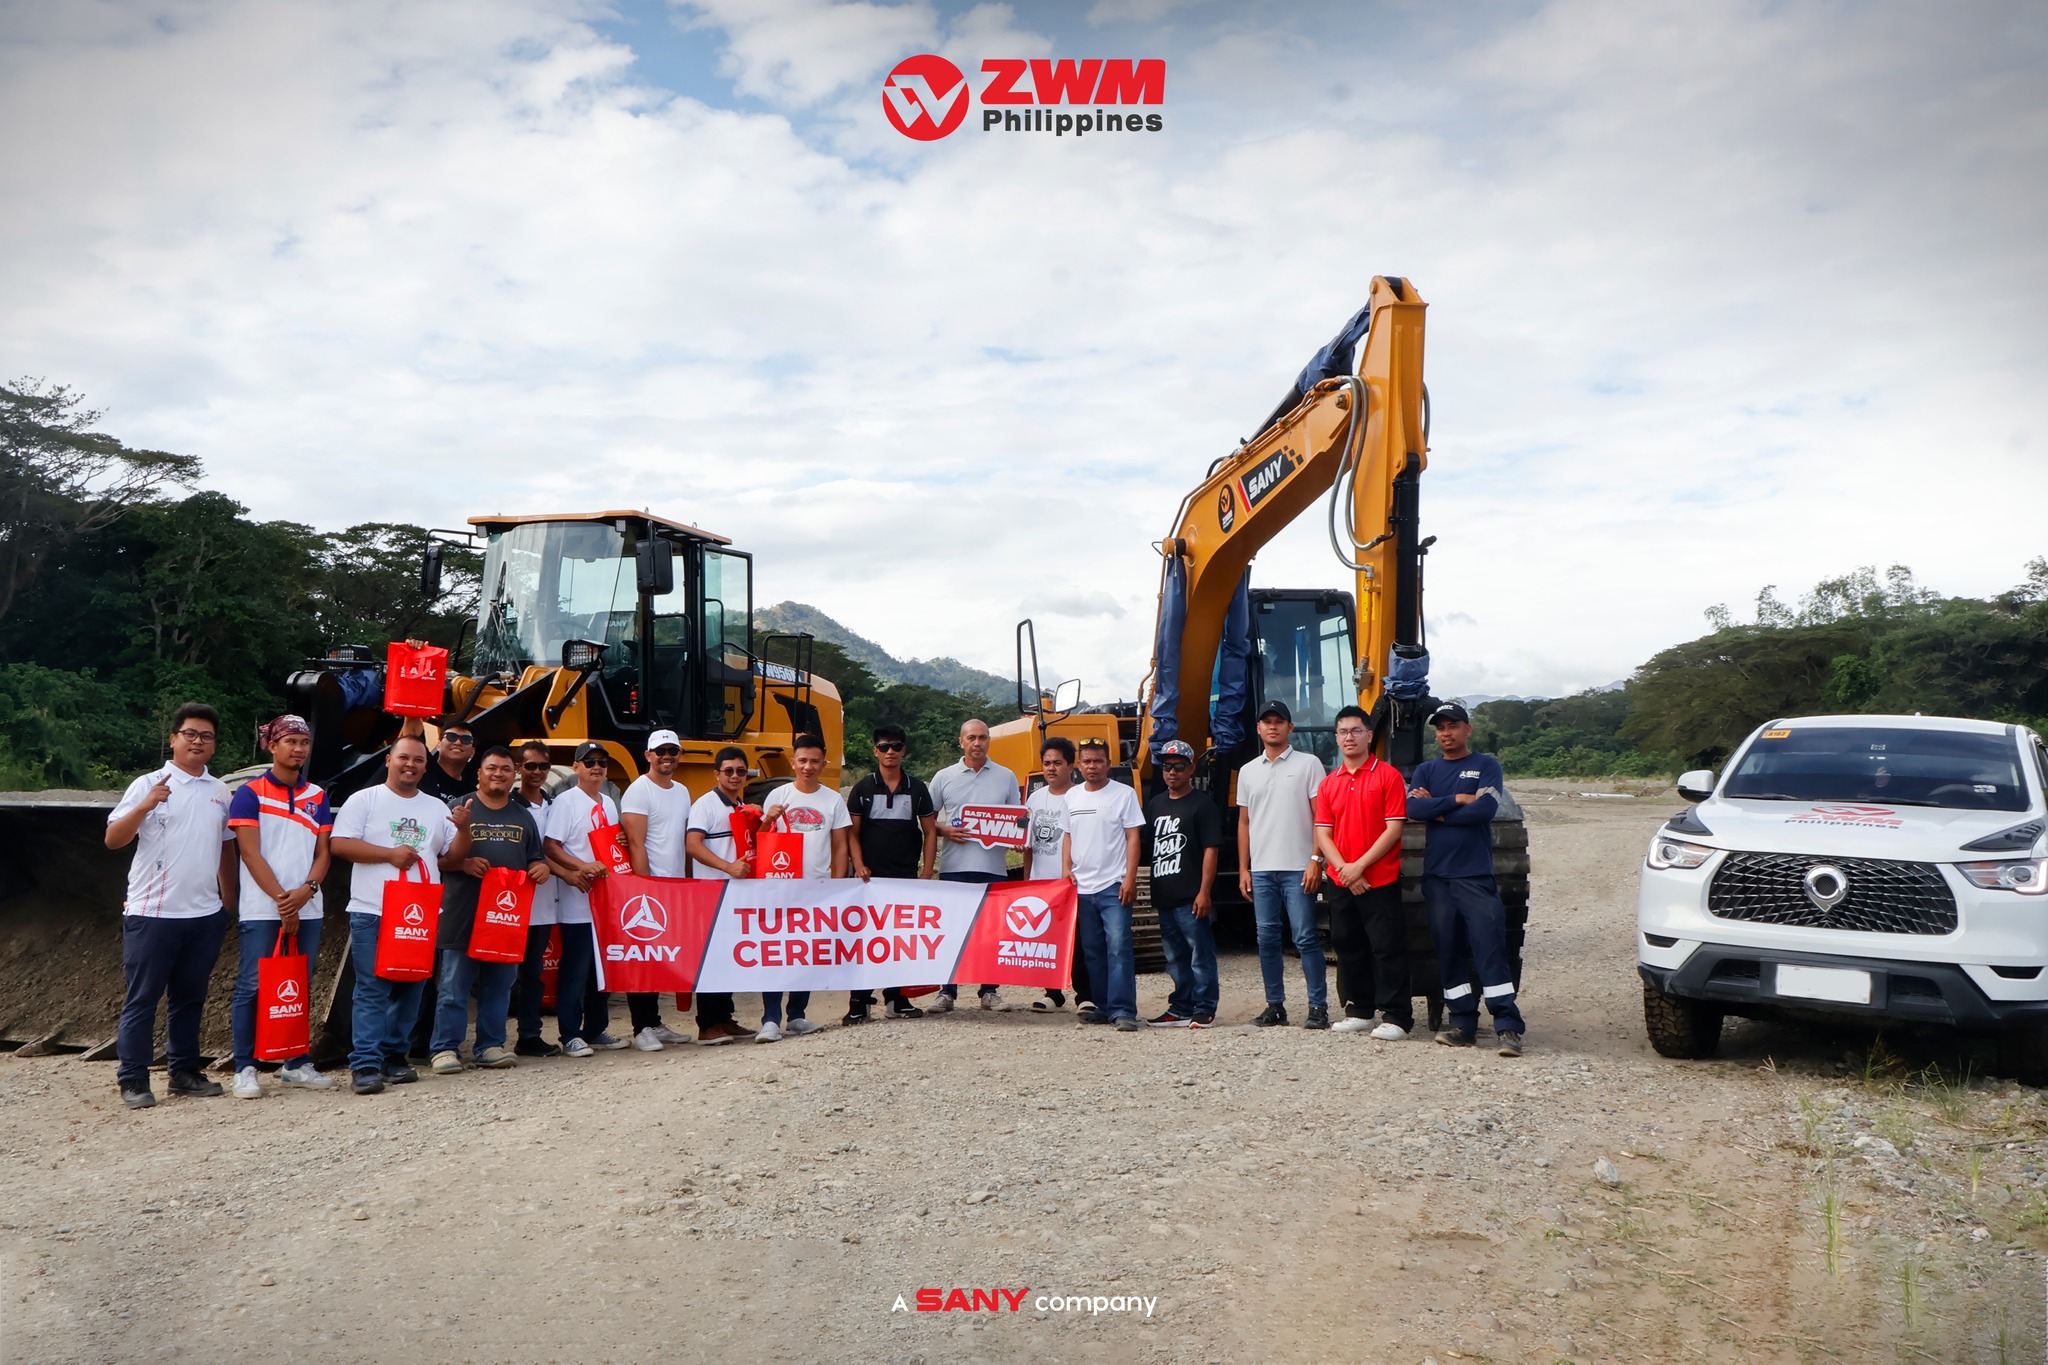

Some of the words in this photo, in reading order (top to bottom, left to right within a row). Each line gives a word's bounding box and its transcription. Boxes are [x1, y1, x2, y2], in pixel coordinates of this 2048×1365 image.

[1248, 455, 1283, 500] SANY
[964, 810, 992, 819] BASTA
[994, 812, 1018, 821] SANY
[1789, 814, 1904, 825] ZWM
[400, 817, 417, 828] 20
[963, 818, 1025, 839] ZWM
[1154, 815, 1180, 836] The
[1784, 820, 1900, 829] Philippines
[391, 830, 427, 841] BATCH
[1153, 833, 1182, 857] best
[613, 862, 631, 873] SANY
[1153, 853, 1181, 878] dad
[486, 911, 521, 922] SANY
[734, 904, 942, 935] TURNOVER
[395, 926, 429, 936] SANY
[606, 944, 681, 962] SANY
[733, 934, 945, 968] CEREMONY
[998, 940, 1057, 960] ZWM
[998, 957, 1057, 969] Philippines
[269, 1003, 303, 1015] SANY
